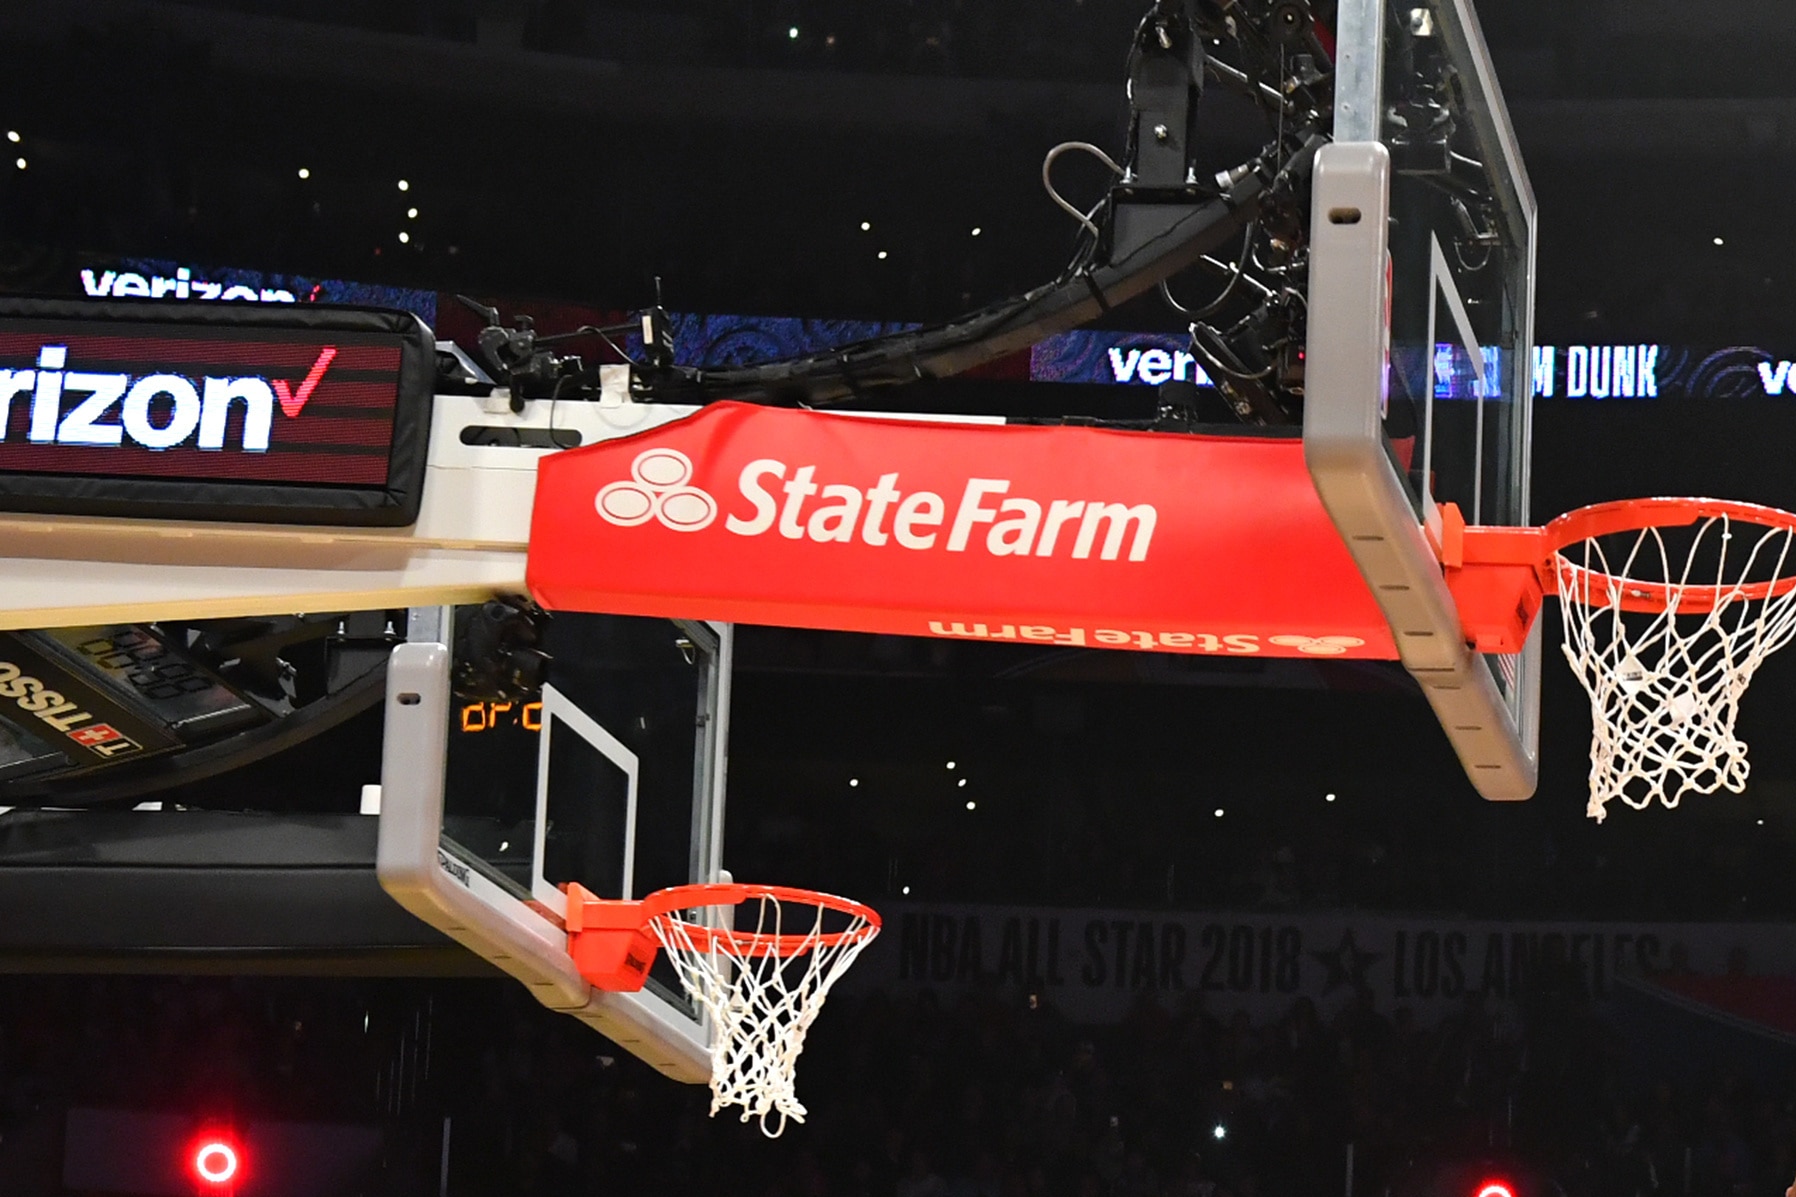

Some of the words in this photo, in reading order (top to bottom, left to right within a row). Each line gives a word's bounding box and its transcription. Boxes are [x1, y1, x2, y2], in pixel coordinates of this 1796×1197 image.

[1567, 344, 1658, 399] DUNK
[724, 458, 946, 551] State
[946, 477, 1159, 562] Farm
[928, 621, 1086, 647] Farm
[1094, 629, 1261, 654] State
[899, 913, 982, 980] NBA
[999, 917, 1065, 986] ALL
[1083, 920, 1189, 991] STAR
[1200, 922, 1302, 993] 2018
[1394, 930, 1467, 999] LOS
